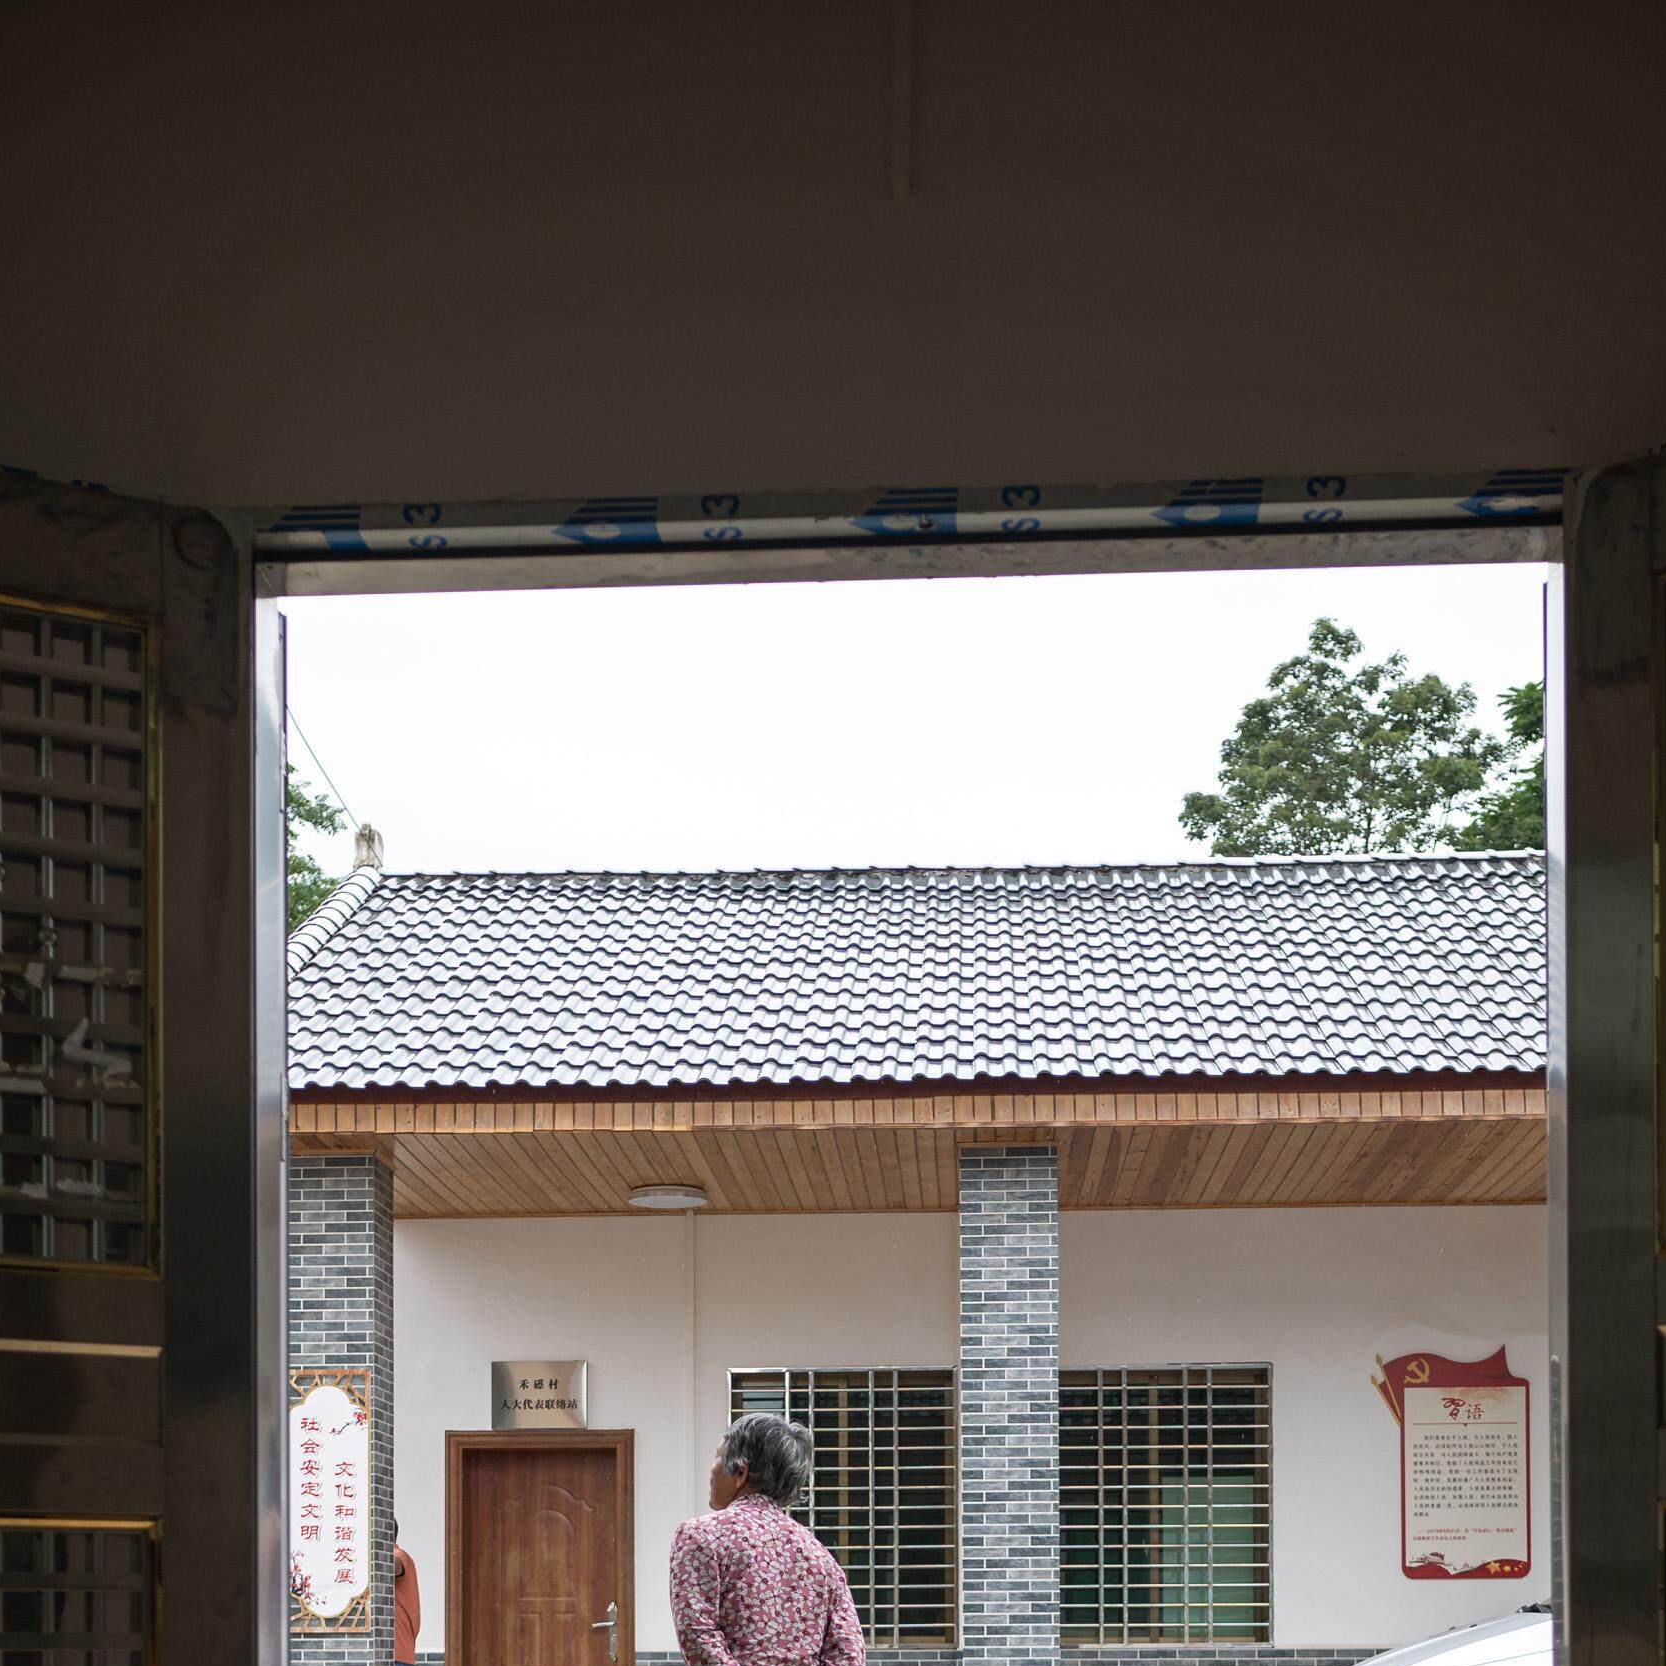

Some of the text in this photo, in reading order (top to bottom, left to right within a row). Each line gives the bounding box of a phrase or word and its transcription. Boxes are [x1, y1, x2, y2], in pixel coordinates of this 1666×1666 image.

[500, 1398, 578, 1411] 人大代表联络站
[299, 1416, 321, 1542] 社会安定文明
[334, 1460, 357, 1585] 文化和谐发展
